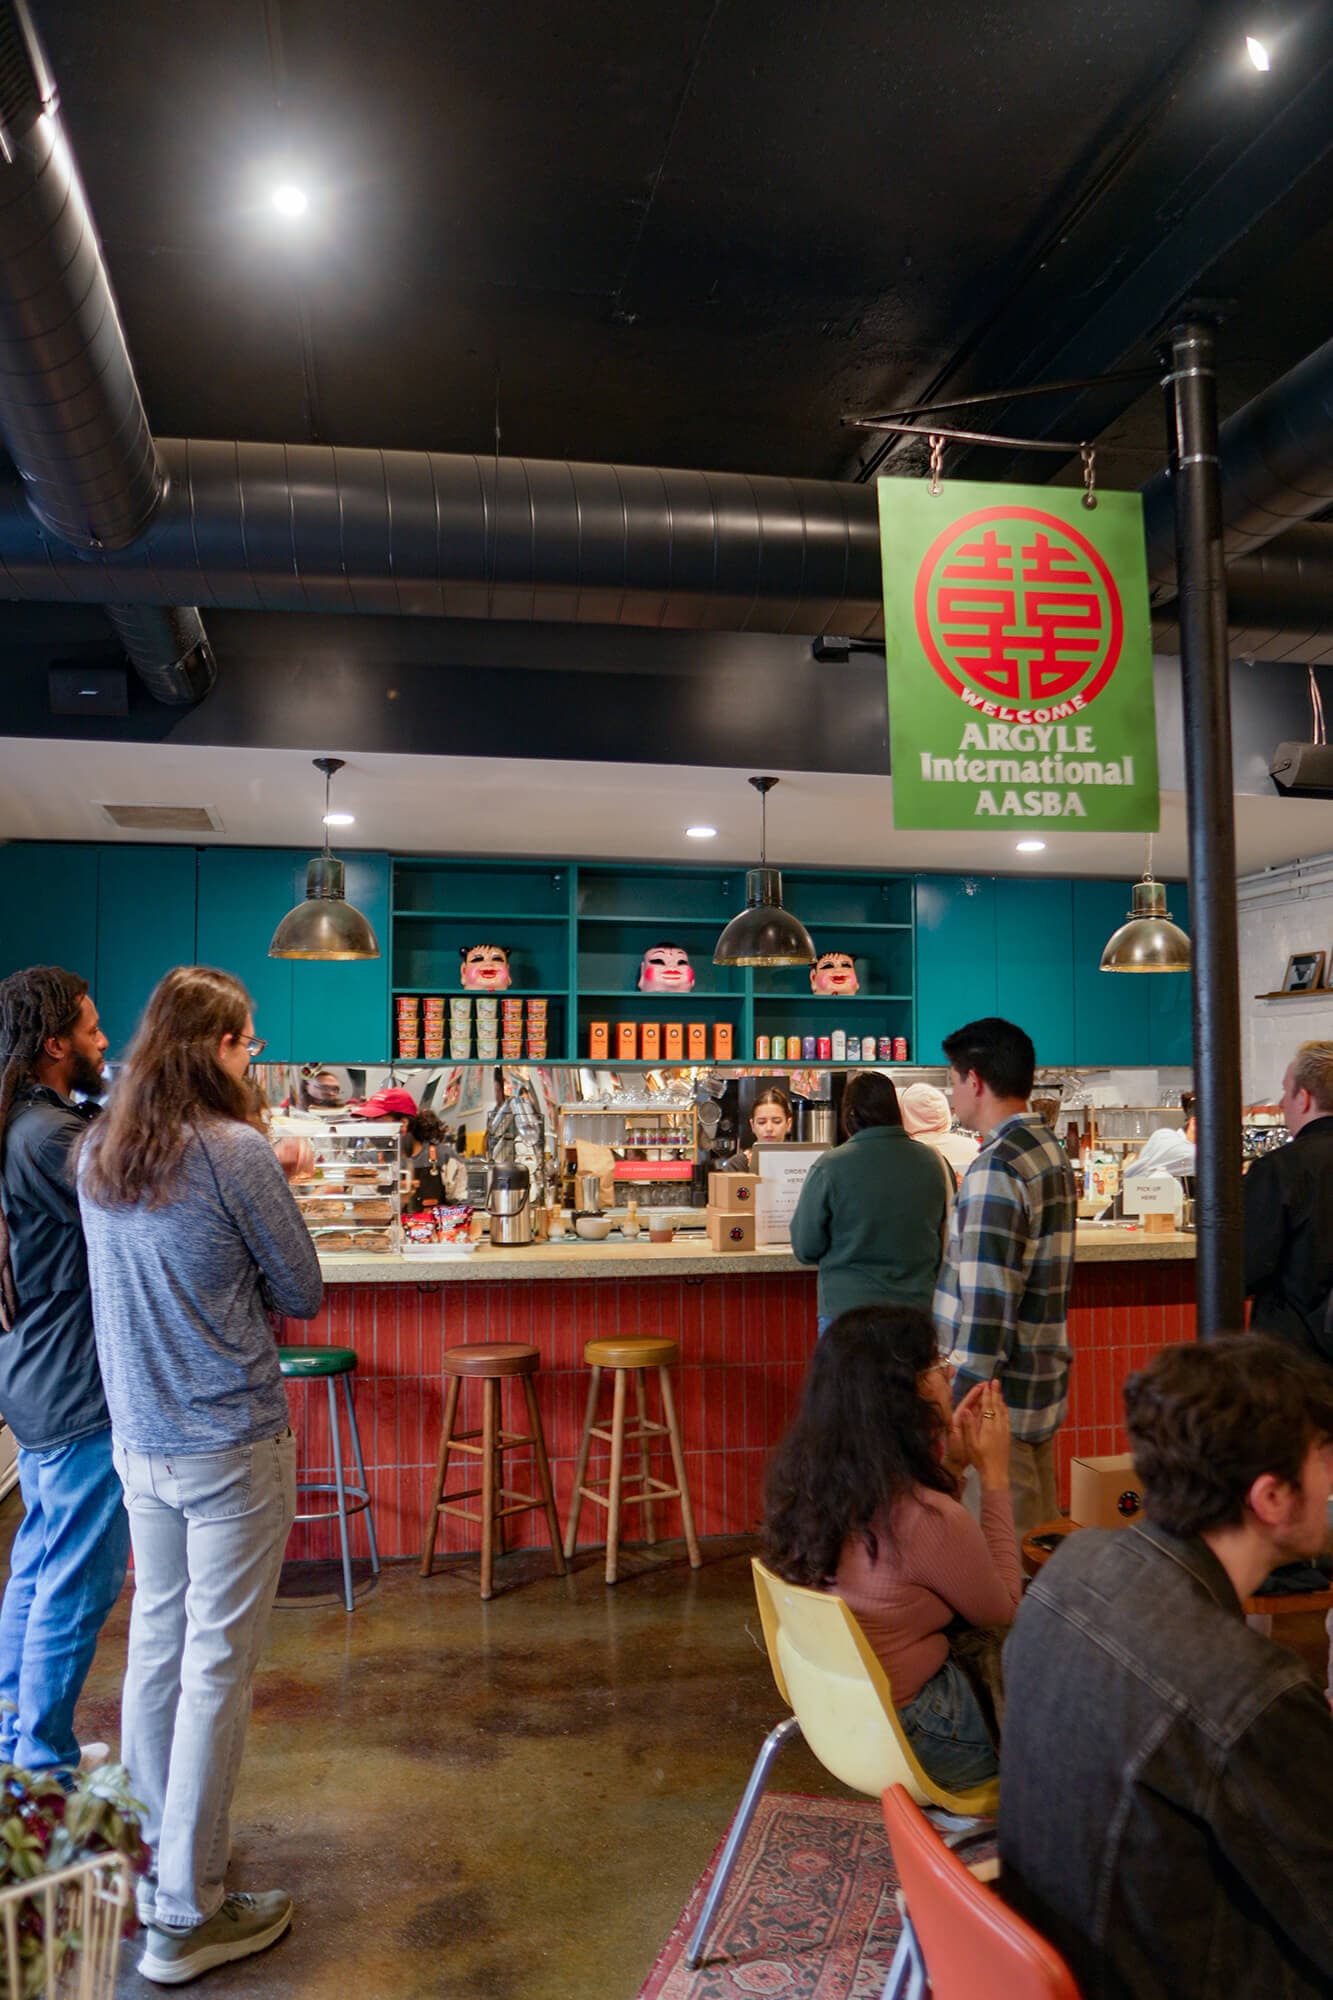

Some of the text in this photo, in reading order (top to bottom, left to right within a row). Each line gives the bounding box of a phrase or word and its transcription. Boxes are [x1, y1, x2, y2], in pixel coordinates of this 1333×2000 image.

[960, 687, 1088, 724] WELCOME
[958, 722, 1097, 753] ARGYLE
[919, 752, 1135, 785] International
[974, 790, 1088, 817] AASBA
